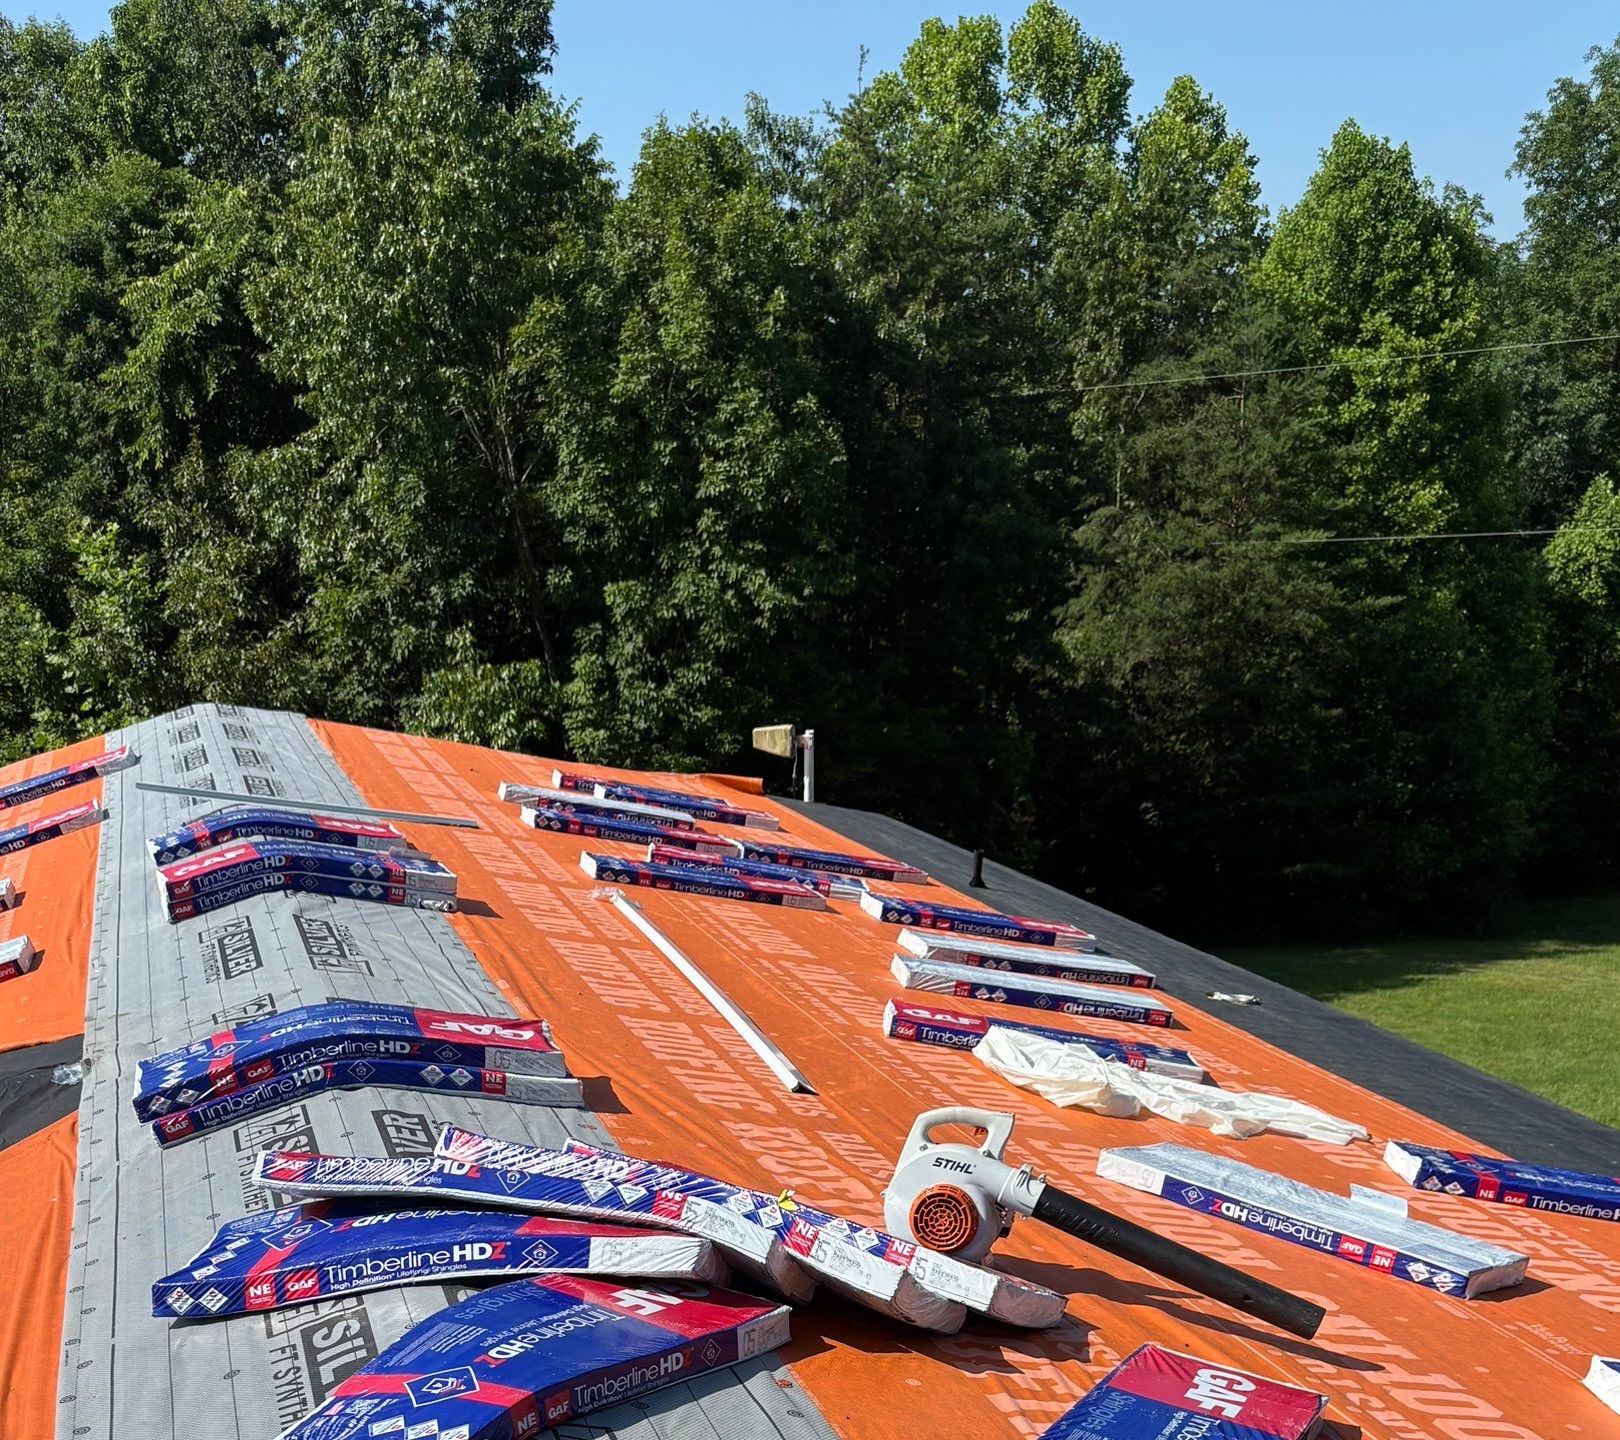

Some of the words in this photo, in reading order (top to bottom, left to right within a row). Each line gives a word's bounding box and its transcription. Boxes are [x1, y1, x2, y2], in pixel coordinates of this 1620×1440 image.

[902, 1007, 982, 1026] GAF
[1130, 1057, 1145, 1068] NE
[165, 1120, 188, 1136] GAF
[485, 1073, 503, 1084] NE
[932, 1157, 973, 1175] STIHL
[1479, 1189, 1495, 1199] NE
[796, 1222, 817, 1238] NE
[891, 1240, 911, 1255] NE
[1341, 1240, 1365, 1255] GAF
[1373, 1255, 1391, 1268] NE
[250, 1283, 271, 1297] NE
[288, 1277, 316, 1291] GAF
[326, 1241, 506, 1281] TimberlineHDZ
[331, 1281, 351, 1291] High
[432, 1261, 467, 1273] Shingles
[516, 1413, 538, 1435] NE
[548, 1400, 570, 1420] GAF
[575, 1349, 693, 1406] TimberlineHDZ
[1184, 1368, 1257, 1419] GAF
